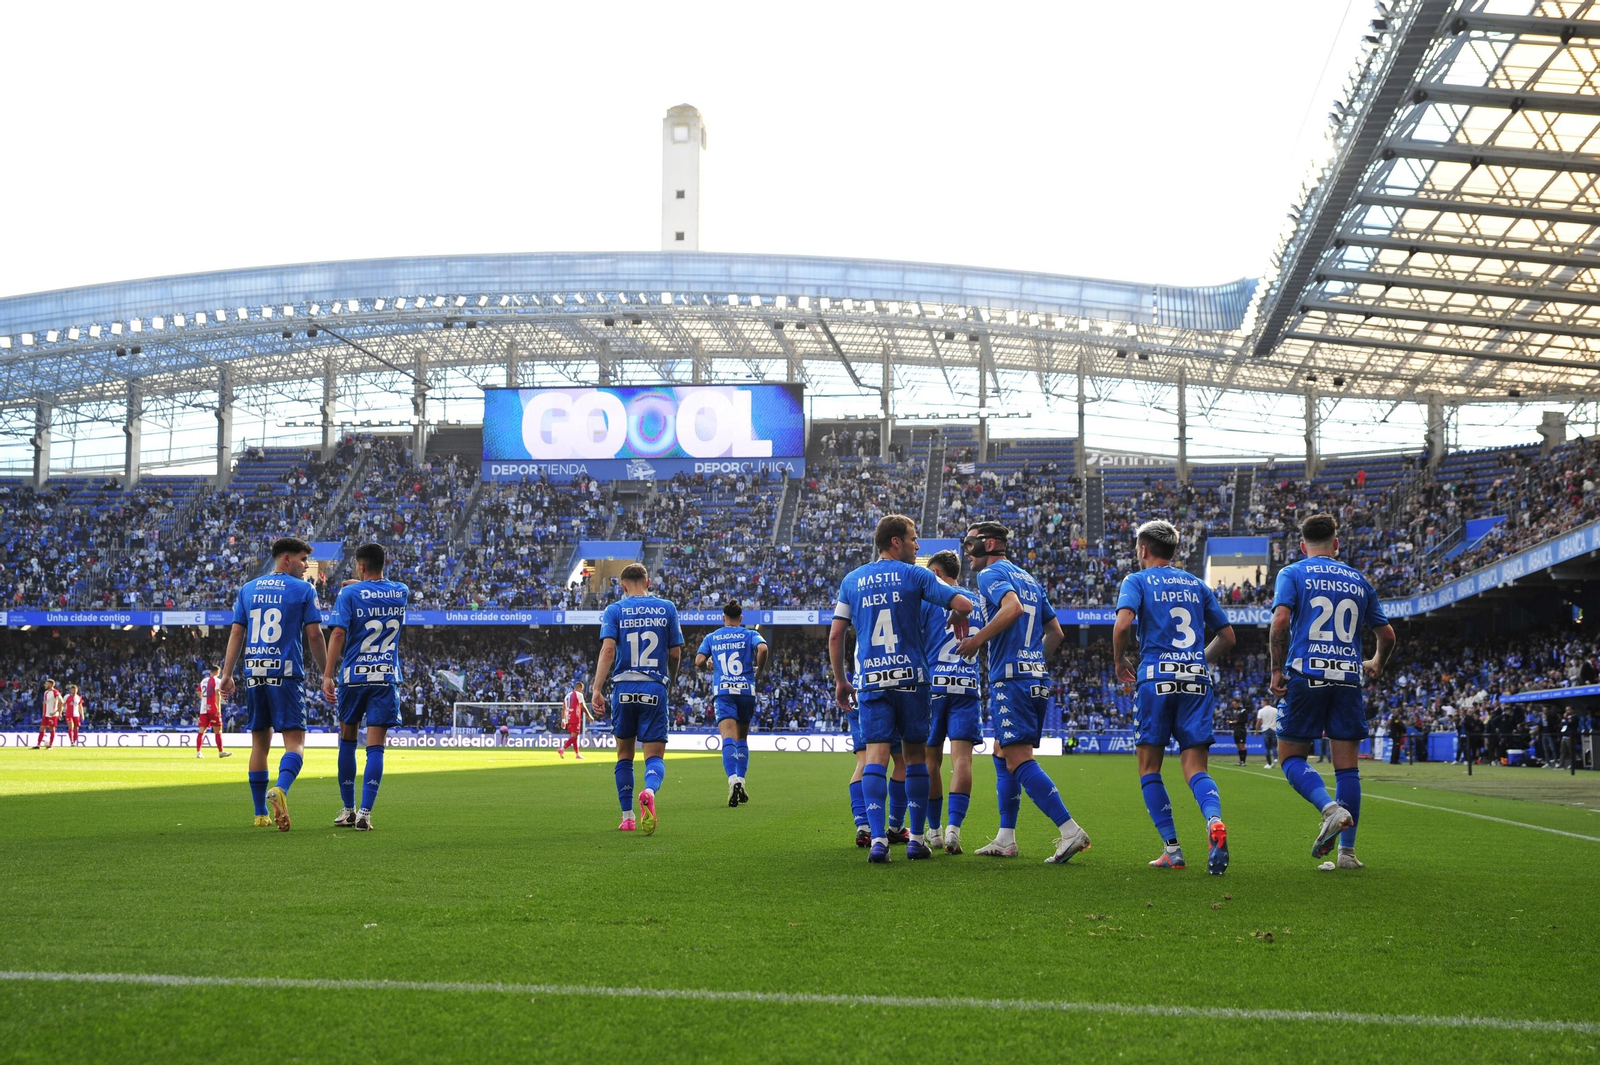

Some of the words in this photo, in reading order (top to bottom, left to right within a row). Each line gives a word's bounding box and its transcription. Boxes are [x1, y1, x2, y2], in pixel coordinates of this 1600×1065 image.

[1306, 565, 1360, 580] PELICANO
[256, 579, 286, 587] PROEL
[857, 572, 901, 588] MASTIL
[1019, 588, 1038, 602] LUCAS
[1305, 579, 1364, 598] SVENSSON
[252, 594, 282, 603] TRILLI
[862, 593, 888, 608] ALEX
[892, 591, 903, 603] B.
[1154, 590, 1200, 603] LAPEÑA
[356, 608, 366, 617] D.
[368, 606, 405, 617] VILLARE
[446, 612, 469, 621] Unha
[471, 612, 498, 621] cidade
[501, 612, 532, 623] contigo
[622, 606, 666, 615] PELICANO
[1077, 612, 1101, 620] Unha
[47, 614, 69, 622] Unha
[72, 613, 98, 622] cidade
[100, 613, 130, 624] contigo
[250, 608, 282, 643] 18
[620, 618, 668, 628] LEBEDENKO
[1023, 604, 1036, 647] 7
[1308, 596, 1359, 643] 20
[871, 609, 899, 654] 4
[1169, 607, 1196, 649] 3
[360, 619, 400, 653] 22
[713, 633, 745, 641] PELICANO
[626, 631, 659, 667] 12
[712, 642, 746, 651] MARTINEZ
[1160, 652, 1203, 660] ABANC
[246, 660, 281, 669] DIGI
[355, 664, 394, 674] DIGI
[718, 652, 743, 676] 16
[1160, 662, 1208, 677] DIGI
[1310, 657, 1358, 674] DIGI
[866, 667, 913, 684] DIGI
[933, 675, 977, 689] DIGI
[720, 682, 748, 690] DIGI
[1156, 681, 1207, 695] DIGI
[620, 693, 658, 705] DIGI
[385, 734, 436, 747] reando
[593, 734, 617, 748] vid
[775, 737, 855, 752] CONS
